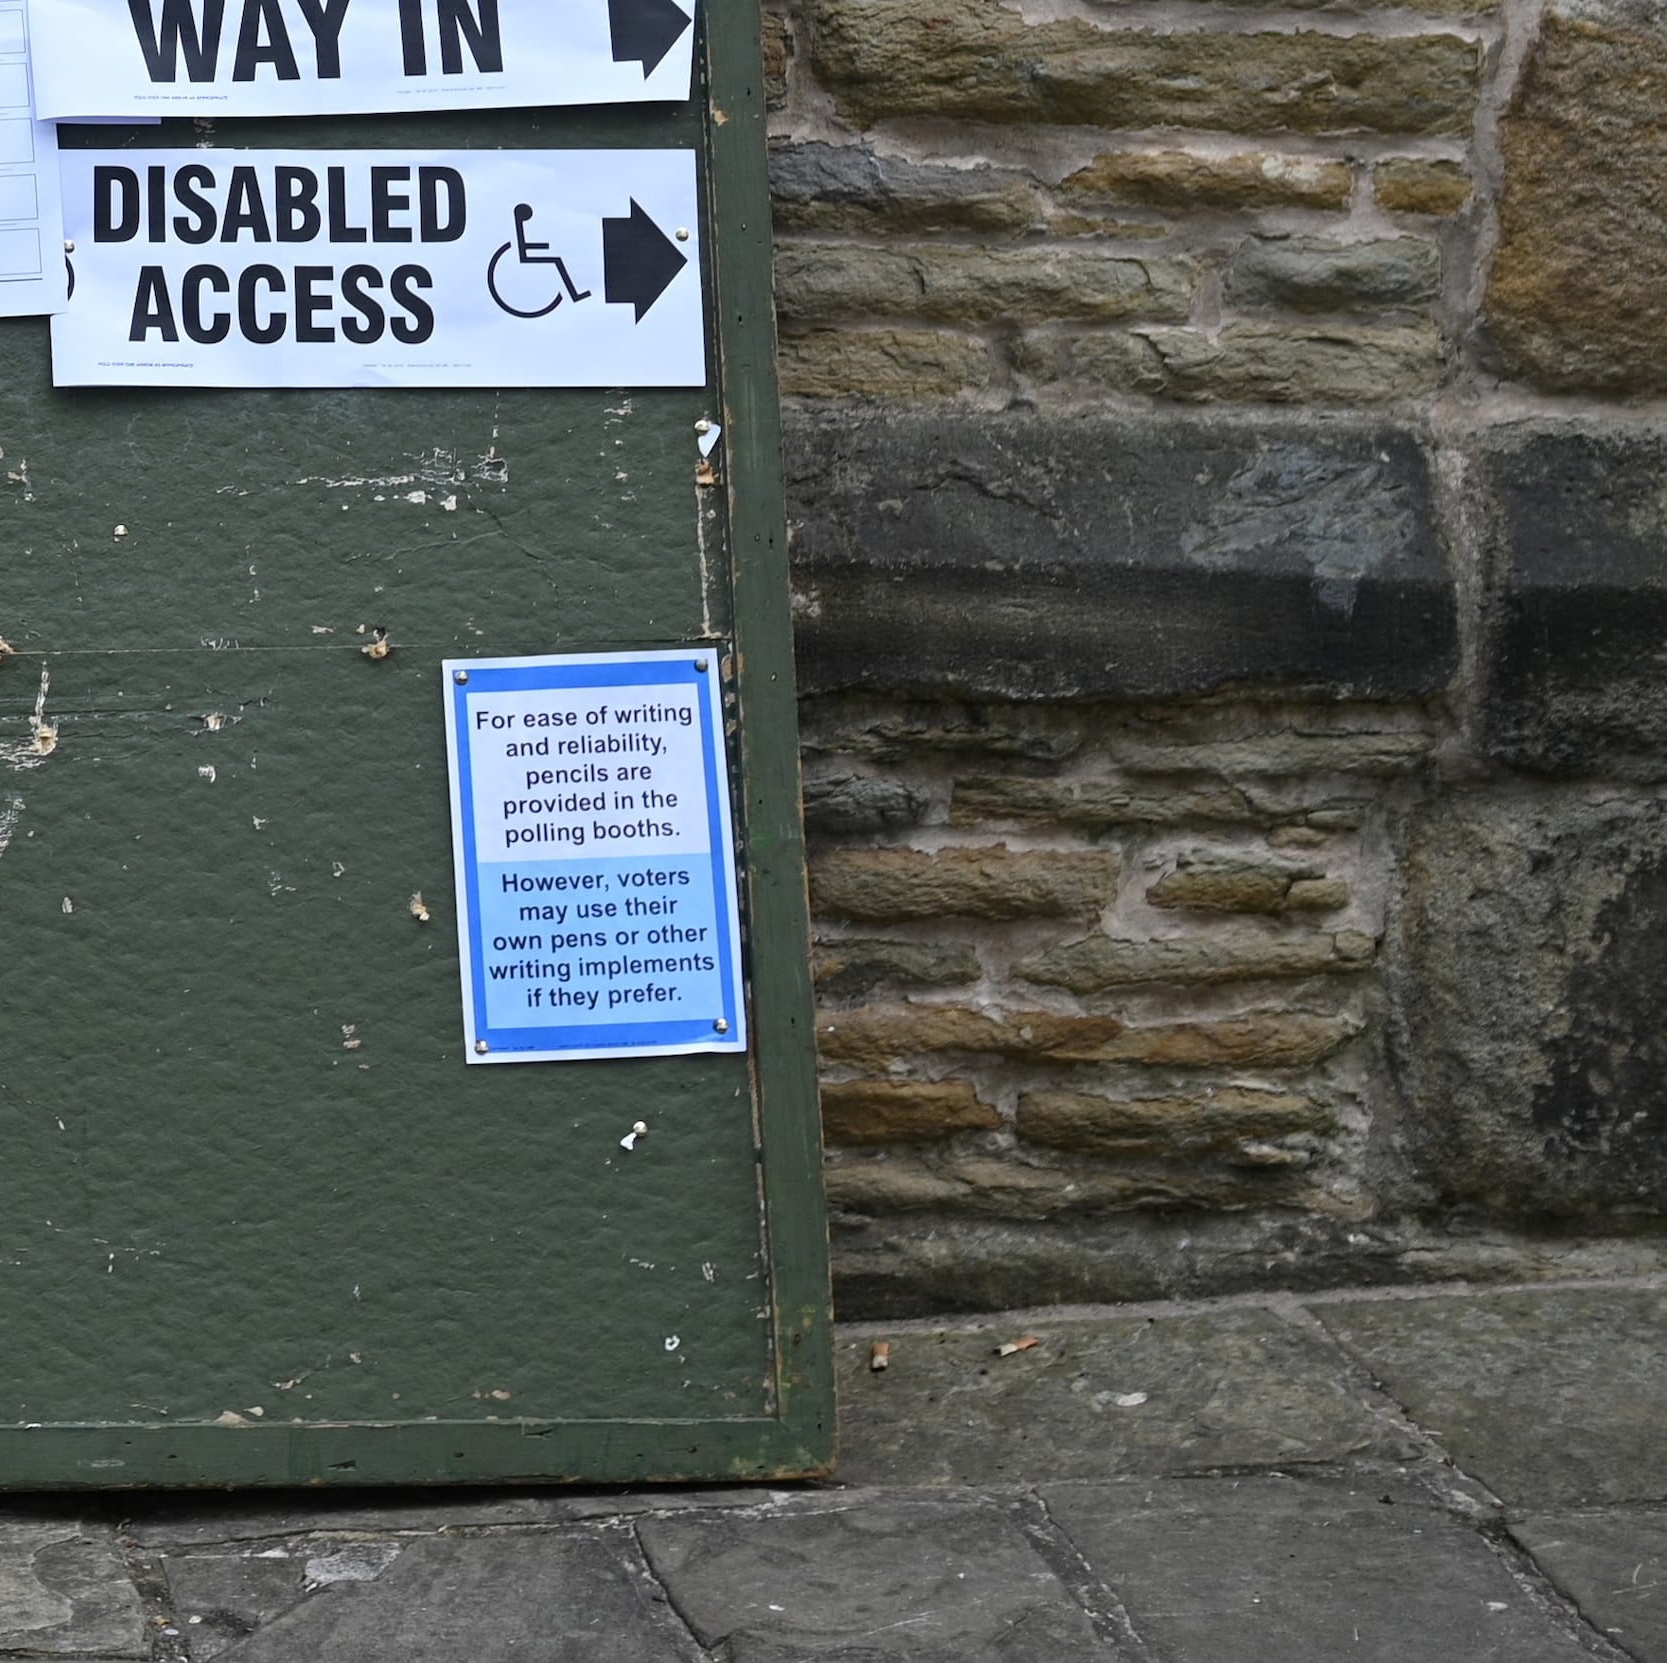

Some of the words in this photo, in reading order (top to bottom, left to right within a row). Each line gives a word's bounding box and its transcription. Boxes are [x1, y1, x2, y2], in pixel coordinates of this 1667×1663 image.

[94, 164, 466, 244] DISABLED
[128, 263, 434, 344] ACCESS
[476, 711, 515, 730] For
[523, 711, 577, 727] ease
[585, 705, 607, 725] of
[614, 703, 691, 726] writing
[506, 736, 549, 757] and
[558, 732, 666, 756] reliability,
[526, 763, 608, 789] pencils
[617, 766, 651, 781] are
[503, 792, 605, 818] provided
[614, 791, 633, 809] in
[641, 789, 677, 808] the
[505, 822, 584, 848] polling
[593, 818, 680, 839] booths.
[502, 873, 609, 892] However,
[617, 868, 690, 887] voters
[519, 905, 567, 924] may
[576, 902, 617, 918] use
[624, 895, 677, 916] their
[493, 935, 542, 950] own
[551, 932, 607, 953] pens
[615, 930, 639, 945] or
[647, 924, 707, 944] other
[488, 958, 570, 982] writing
[578, 954, 714, 980] implements
[527, 987, 542, 1007] if
[548, 987, 599, 1010] they
[608, 982, 681, 1008] prefer.
